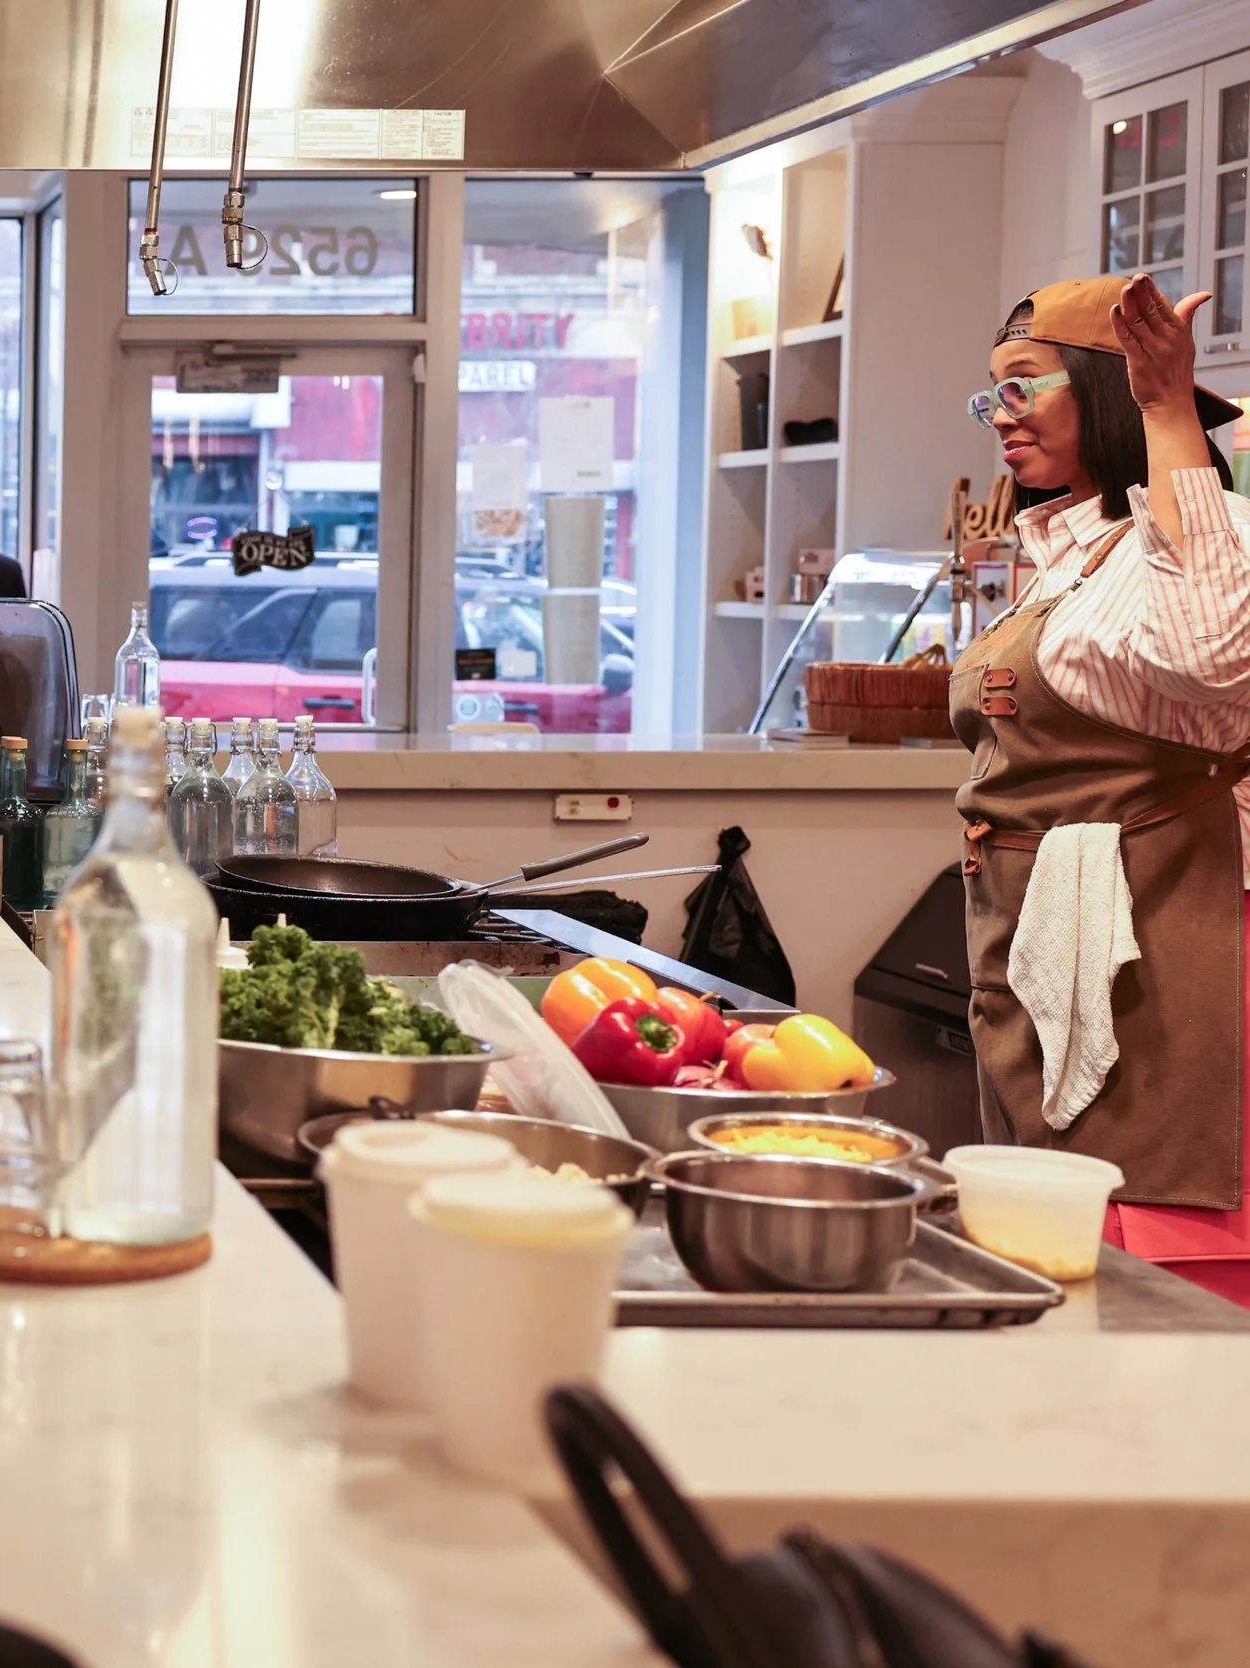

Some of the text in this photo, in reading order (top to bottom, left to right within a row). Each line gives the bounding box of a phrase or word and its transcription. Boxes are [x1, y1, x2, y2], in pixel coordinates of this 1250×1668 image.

[459, 313, 574, 350] BRITY
[943, 475, 1014, 541] hell
[241, 543, 308, 567] OPEN
